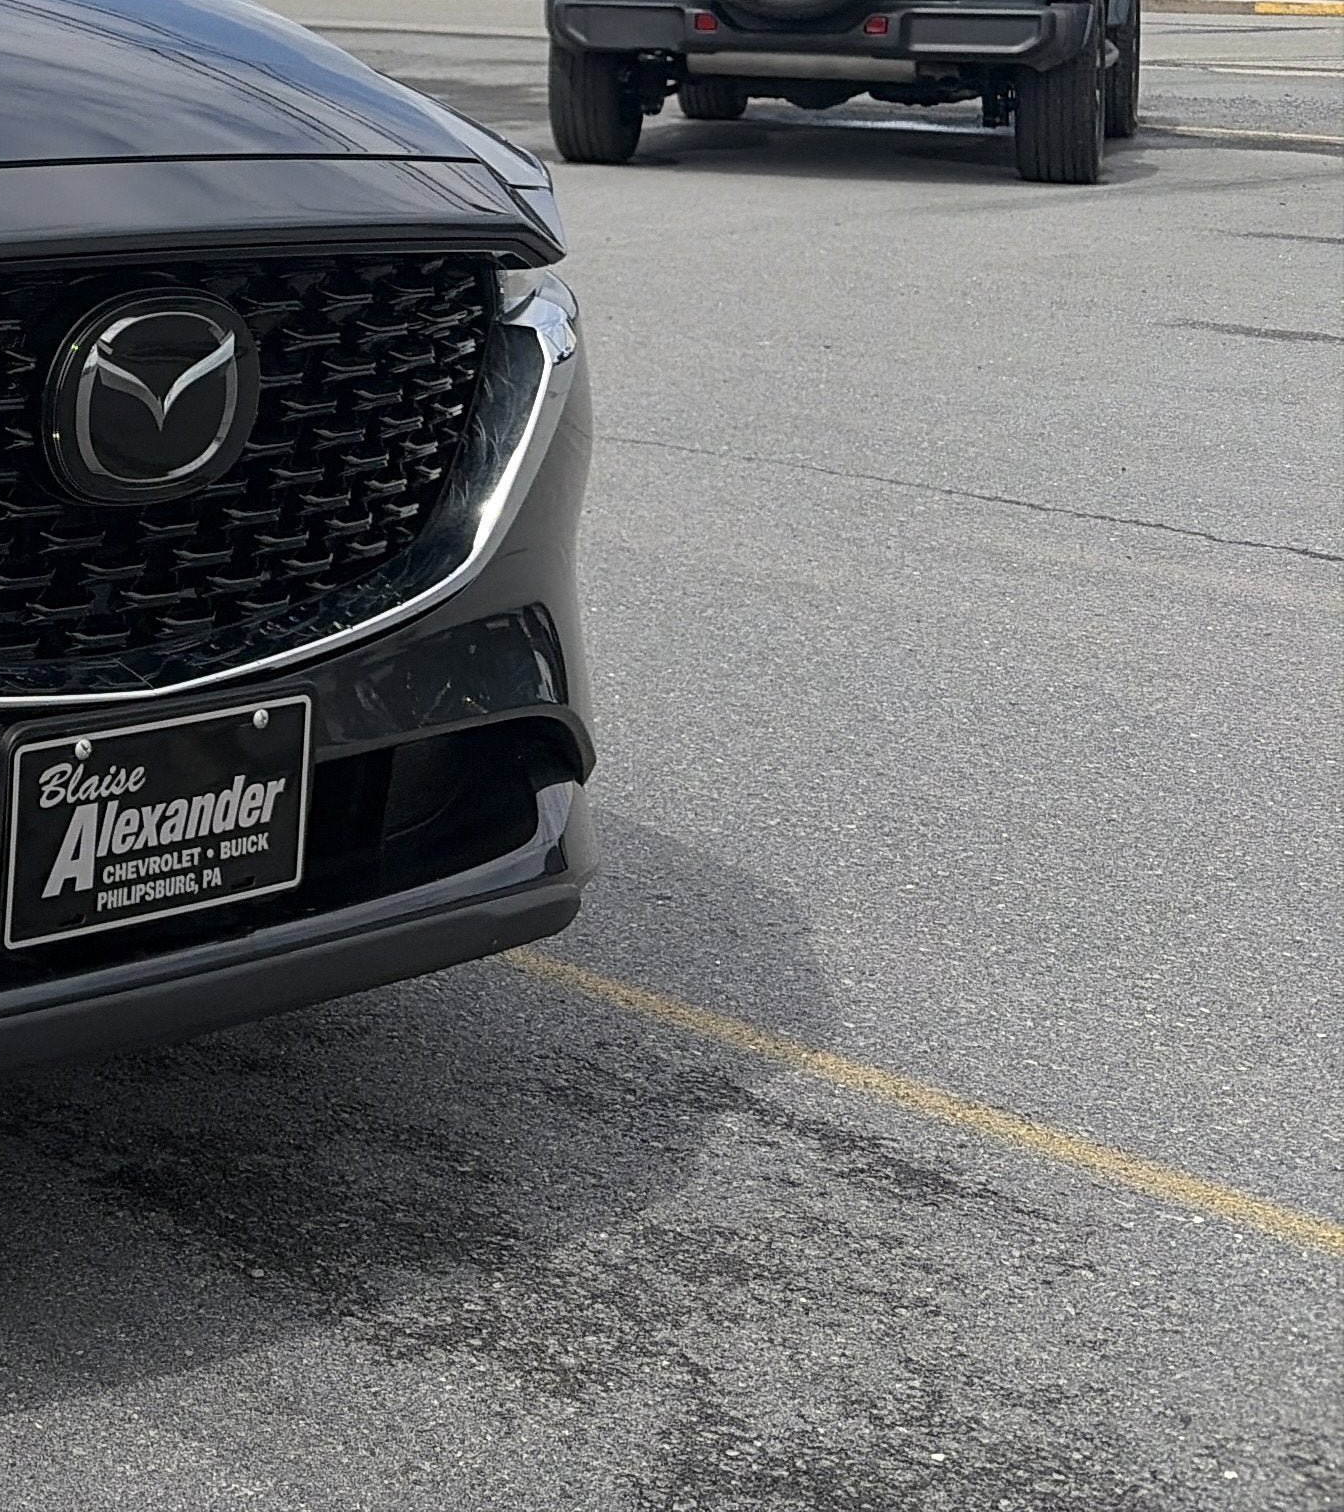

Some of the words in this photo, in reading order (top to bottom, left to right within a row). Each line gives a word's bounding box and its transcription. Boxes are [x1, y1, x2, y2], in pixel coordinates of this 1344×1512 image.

[38, 762, 146, 809] Blaise
[41, 774, 287, 900] Alexander
[102, 846, 202, 885] CHEVROLET
[219, 831, 270, 861] BUICK
[96, 874, 200, 912] PHILIPSBURG,
[202, 867, 223, 891] PA
